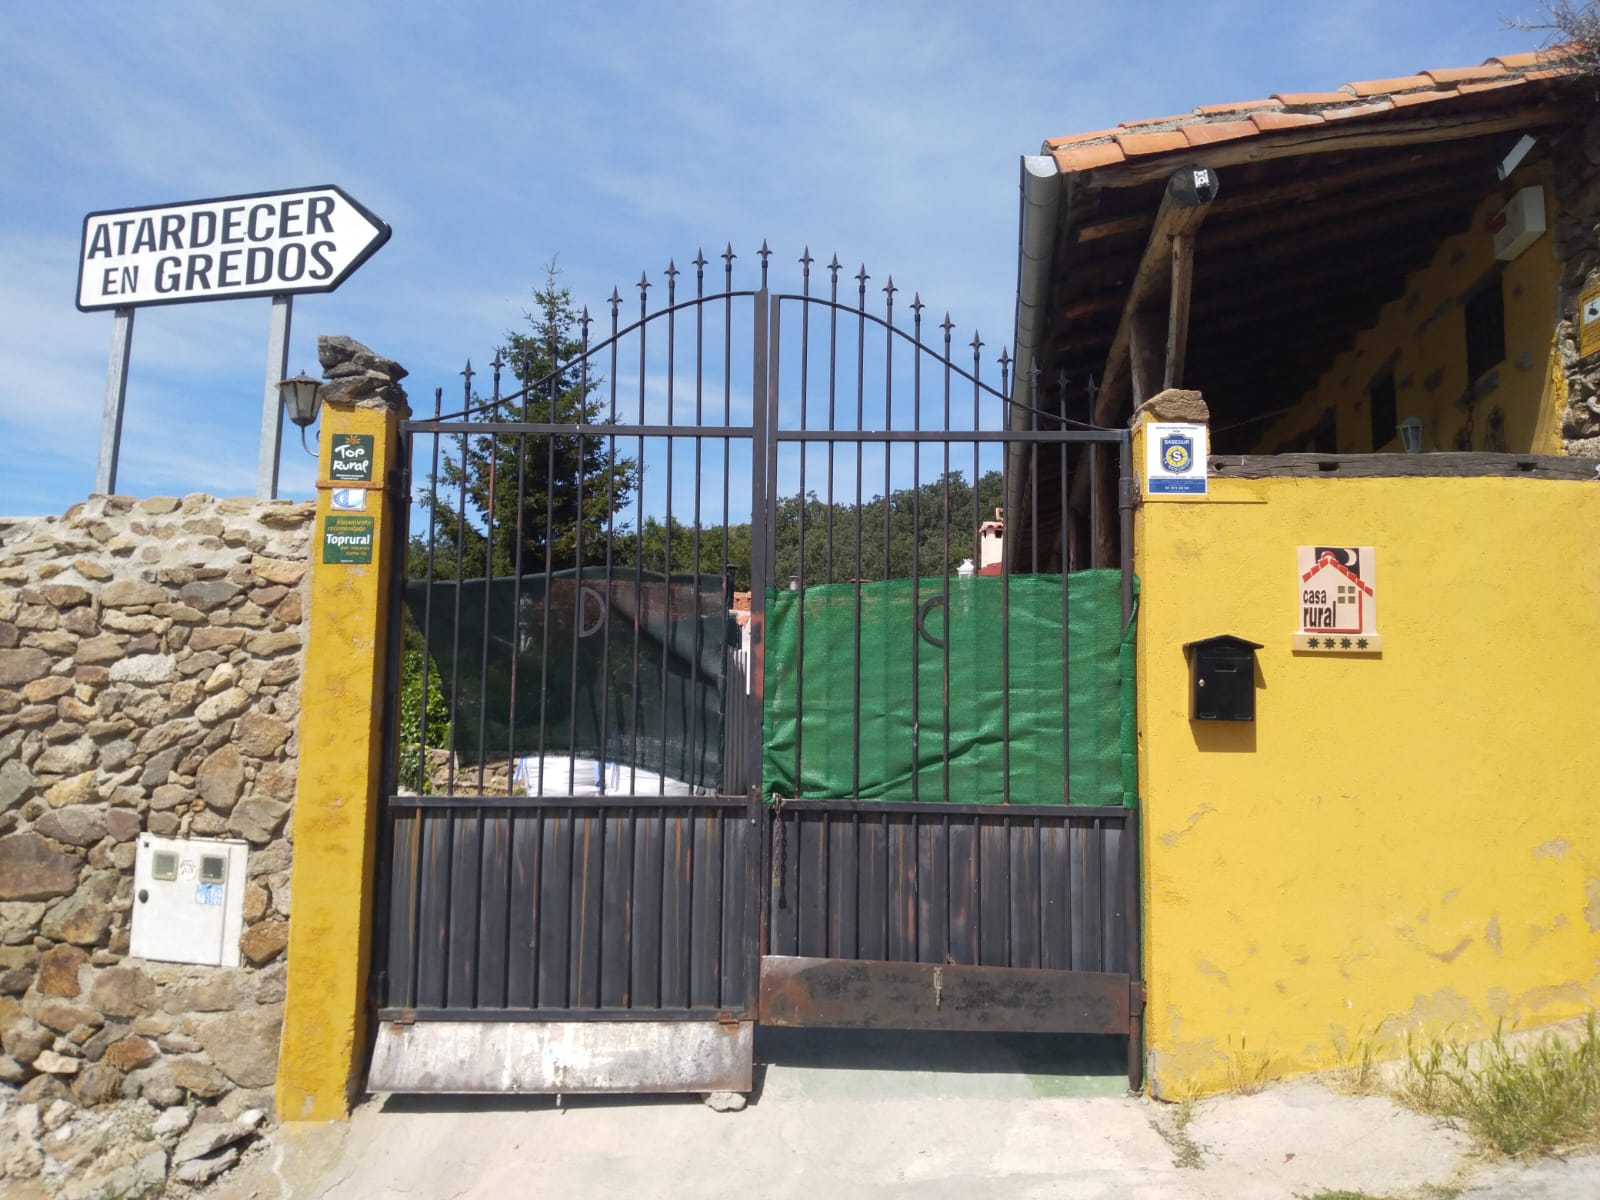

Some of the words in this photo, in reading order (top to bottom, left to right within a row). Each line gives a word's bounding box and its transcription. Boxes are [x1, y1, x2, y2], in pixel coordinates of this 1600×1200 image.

[87, 196, 336, 260] ATARDECER
[101, 265, 139, 296] EN
[154, 240, 337, 293] GREDOS
[334, 444, 365, 459] Top
[1172, 451, 1182, 462] S
[332, 459, 369, 473] Rural
[326, 533, 371, 547] Toprural
[1303, 589, 1327, 604] casa
[1303, 600, 1336, 628] rural
